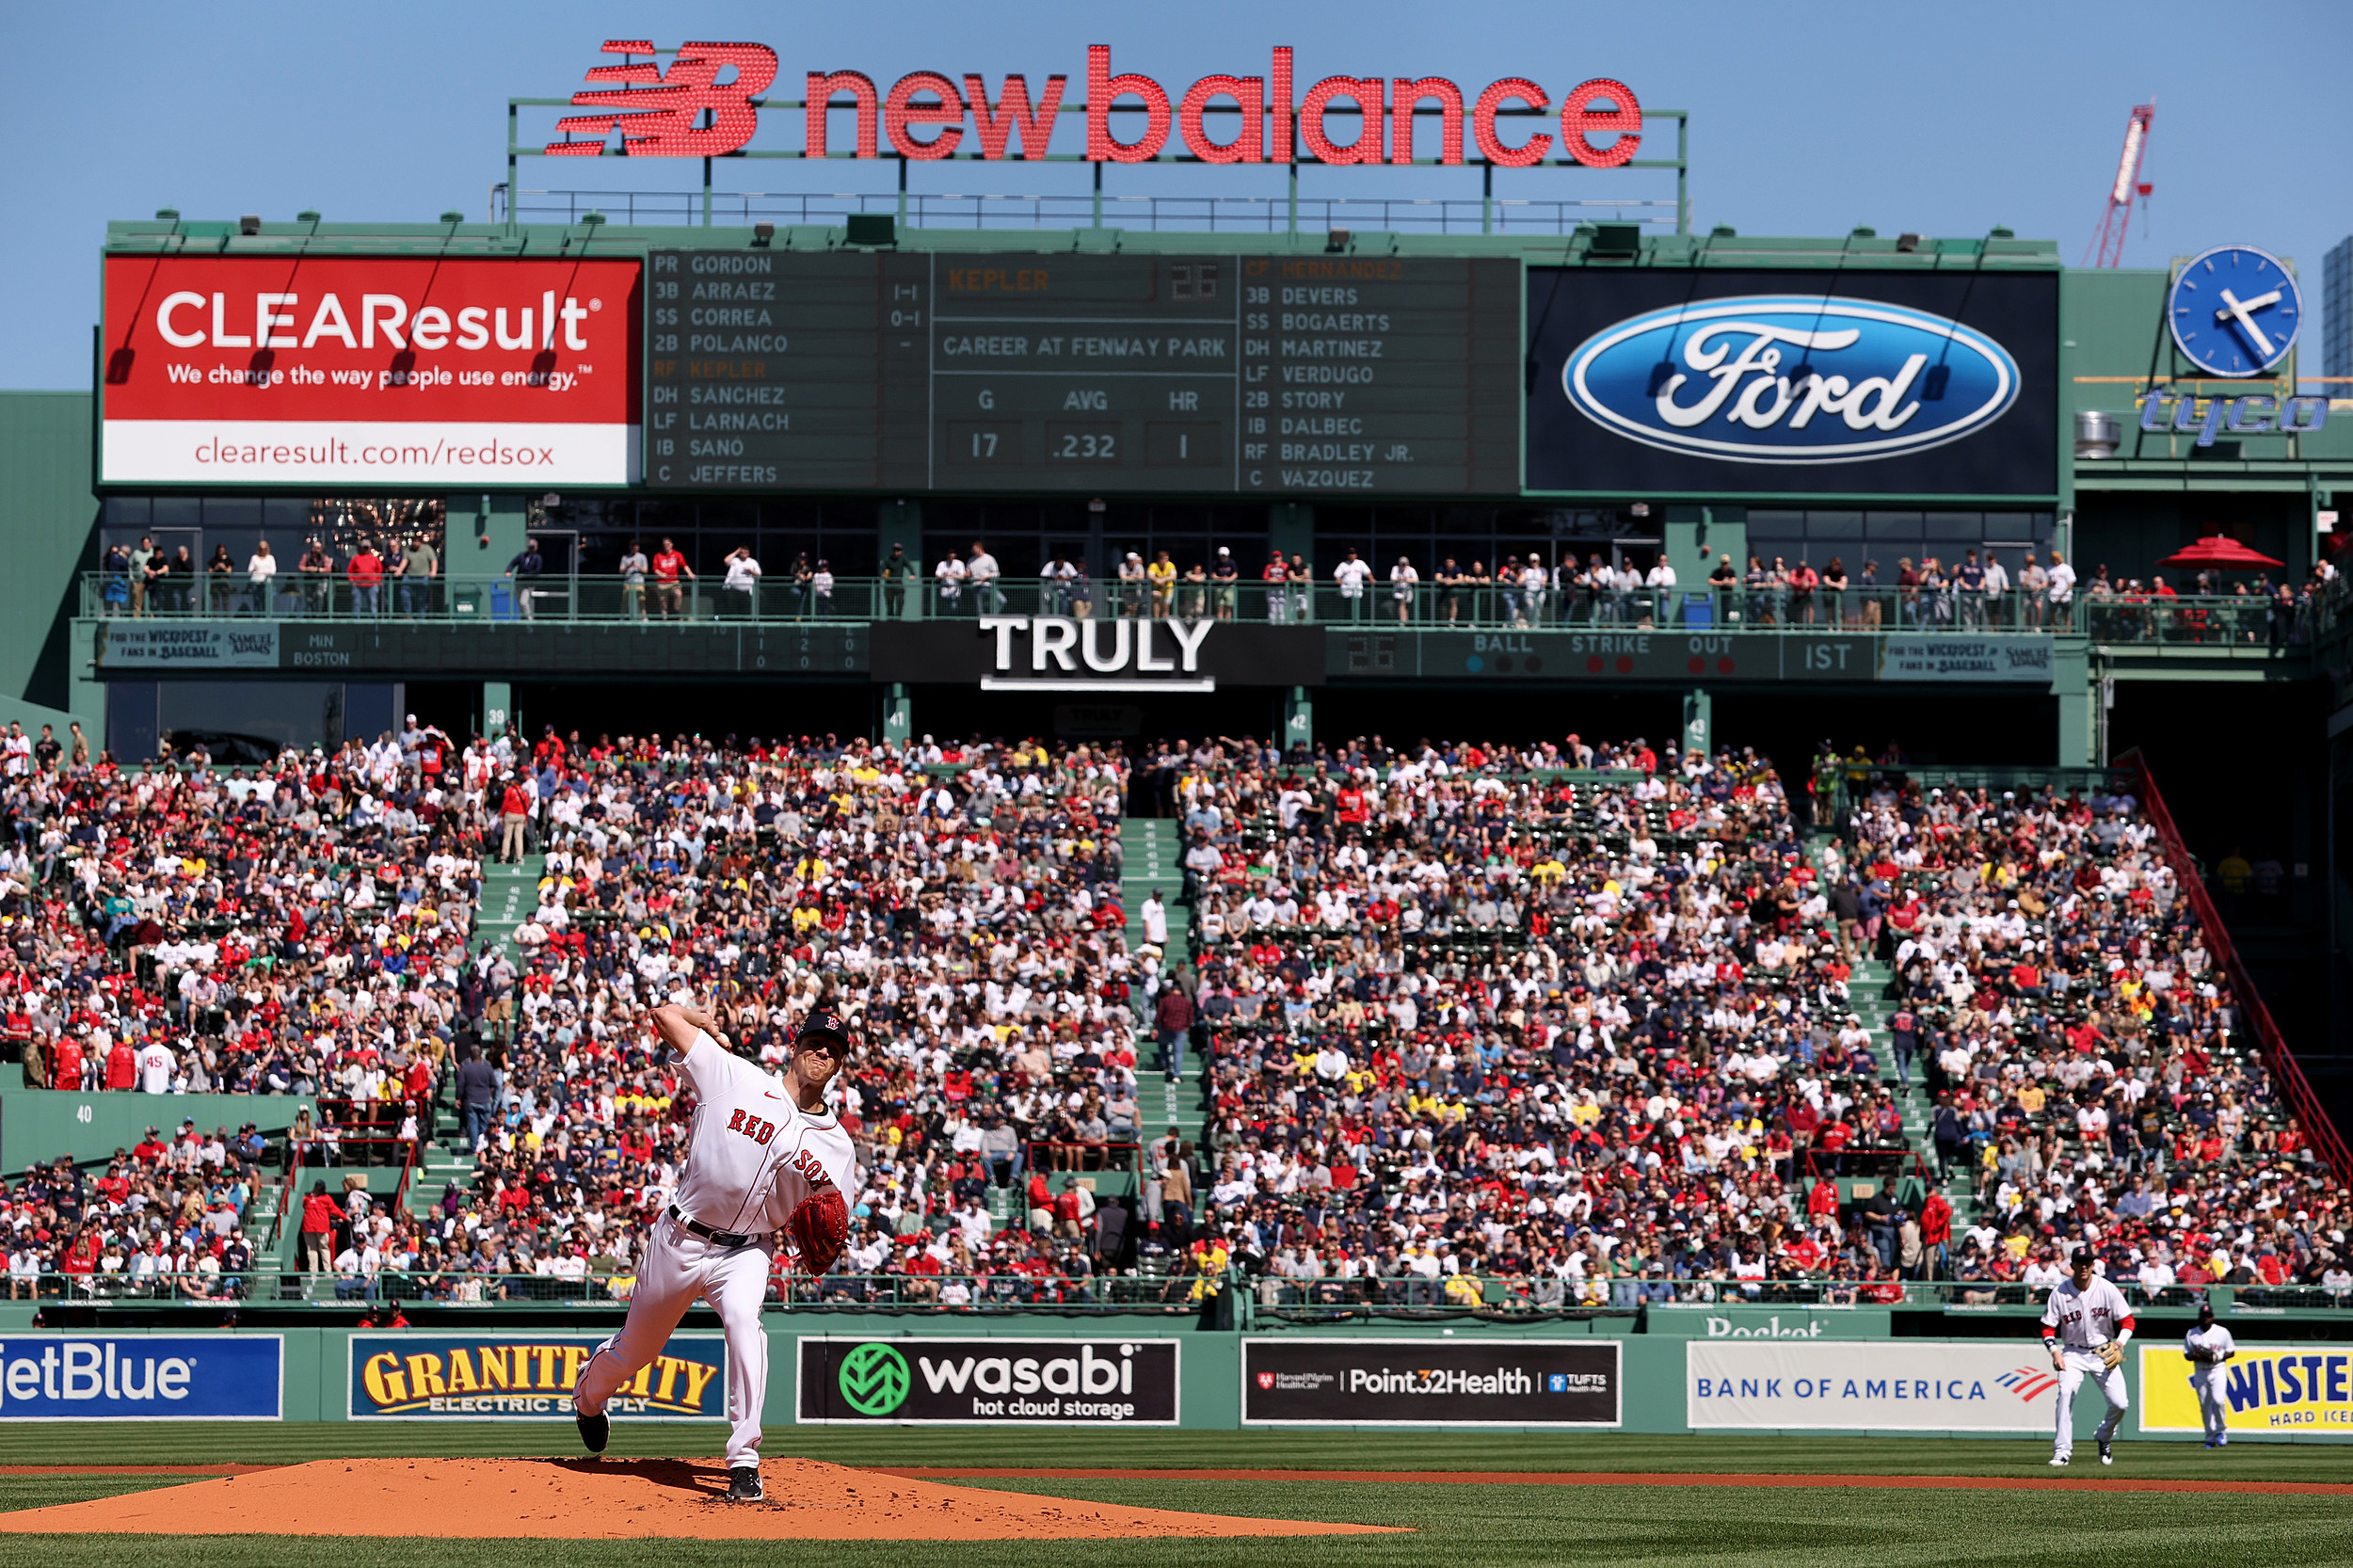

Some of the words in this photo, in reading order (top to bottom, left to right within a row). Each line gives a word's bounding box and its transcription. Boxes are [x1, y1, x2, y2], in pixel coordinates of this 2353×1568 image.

[804, 69, 1068, 161] new
[1088, 44, 1643, 168] balance
[655, 256, 678, 273] PR
[692, 256, 772, 274] GORDON
[950, 269, 1049, 291] KEPLER
[655, 282, 679, 299] 3B
[692, 282, 776, 300] ARRAEZ
[1246, 287, 1270, 304] 3B
[1282, 288, 1358, 305] DEVERS
[655, 309, 678, 326] SS
[691, 308, 773, 327] CORREA
[1247, 313, 1270, 330] SS
[1282, 313, 1390, 331] BOGAERTS
[654, 335, 679, 351] 2B
[690, 335, 788, 353] POLANCO
[943, 336, 1028, 356] CAREER
[1037, 337, 1064, 356] AT
[1071, 338, 1161, 357] FENWAY
[1167, 338, 1226, 358] PARK
[1245, 340, 1270, 356] DH
[1282, 340, 1383, 358] MARTINEZ
[168, 363, 202, 384] We
[208, 364, 284, 389] change
[290, 363, 325, 384] the
[331, 368, 374, 389] way
[379, 366, 453, 391] people
[458, 369, 495, 386] use
[654, 361, 677, 376] RF
[690, 360, 766, 378] KEPLER
[1245, 366, 1270, 382] LF
[1282, 366, 1374, 384] VERDUGO
[1656, 321, 1928, 431] Ford
[654, 388, 678, 404] DH
[978, 390, 995, 409] G
[1063, 391, 1108, 410] AVG
[1169, 392, 1198, 410] HR
[1245, 392, 1270, 408] 2B
[1282, 392, 1345, 409] STORY
[654, 414, 677, 430] LF
[690, 413, 789, 431] LARNACH
[2139, 384, 2329, 447] tyco
[1281, 418, 1363, 435] DALBEC
[195, 437, 554, 467] clearesult.com/redsox
[1053, 435, 1115, 458] .232
[1245, 444, 1268, 460] RF
[1281, 444, 1375, 461] BRADLEY
[1385, 444, 1415, 462] JR.
[658, 466, 671, 481] C
[690, 466, 776, 484] JEFFERS
[1250, 471, 1263, 486] C
[228, 632, 276, 646] SAMUEL
[309, 634, 333, 648] MIN
[800, 637, 809, 650] 2
[844, 637, 854, 651] 0
[979, 616, 1214, 673] TRULY
[1473, 635, 1533, 652] BALL
[1571, 635, 1651, 653] STRIKE
[1689, 636, 1732, 653] OUT
[121, 648, 145, 657] FANS
[158, 646, 219, 660] BASEBALL
[232, 643, 271, 656] ADAMS
[2006, 646, 2050, 660] SAMUEL
[294, 652, 350, 665] BOSTON
[757, 655, 765, 667] 0
[800, 655, 809, 667] 0
[844, 655, 854, 667] 0
[1937, 660, 1997, 672] BASEBALL
[2009, 656, 2048, 669] ADAMS
[488, 709, 505, 725] 39
[888, 711, 904, 727] 41
[1290, 713, 1306, 730] 42
[1689, 719, 1705, 735] 43
[383, 772, 393, 785] K
[824, 1016, 840, 1031] B
[147, 1055, 163, 1067] 45
[76, 1105, 92, 1123] 40
[728, 1108, 776, 1145] RED
[792, 1149, 832, 1192] SOX
[2063, 1309, 2083, 1325] RED
[2090, 1306, 2111, 1319] SOX
[919, 1344, 1133, 1395] wasabi
[616, 1354, 718, 1409] ITY
[1350, 1368, 1531, 1394] Point32Health
[1566, 1373, 1607, 1385] TUFTS
[2188, 1355, 2353, 1414] WISTE
[1698, 1378, 1783, 1399] BANK
[1794, 1379, 1832, 1399] OF
[1842, 1380, 1986, 1400] AMERICA
[429, 1397, 552, 1413] ELECTRIC
[556, 1397, 650, 1413] SPLY
[973, 1398, 1005, 1416] hot
[1008, 1398, 1060, 1416] cloud
[1064, 1400, 1135, 1420] storage
[2269, 1412, 2315, 1426] HARD
